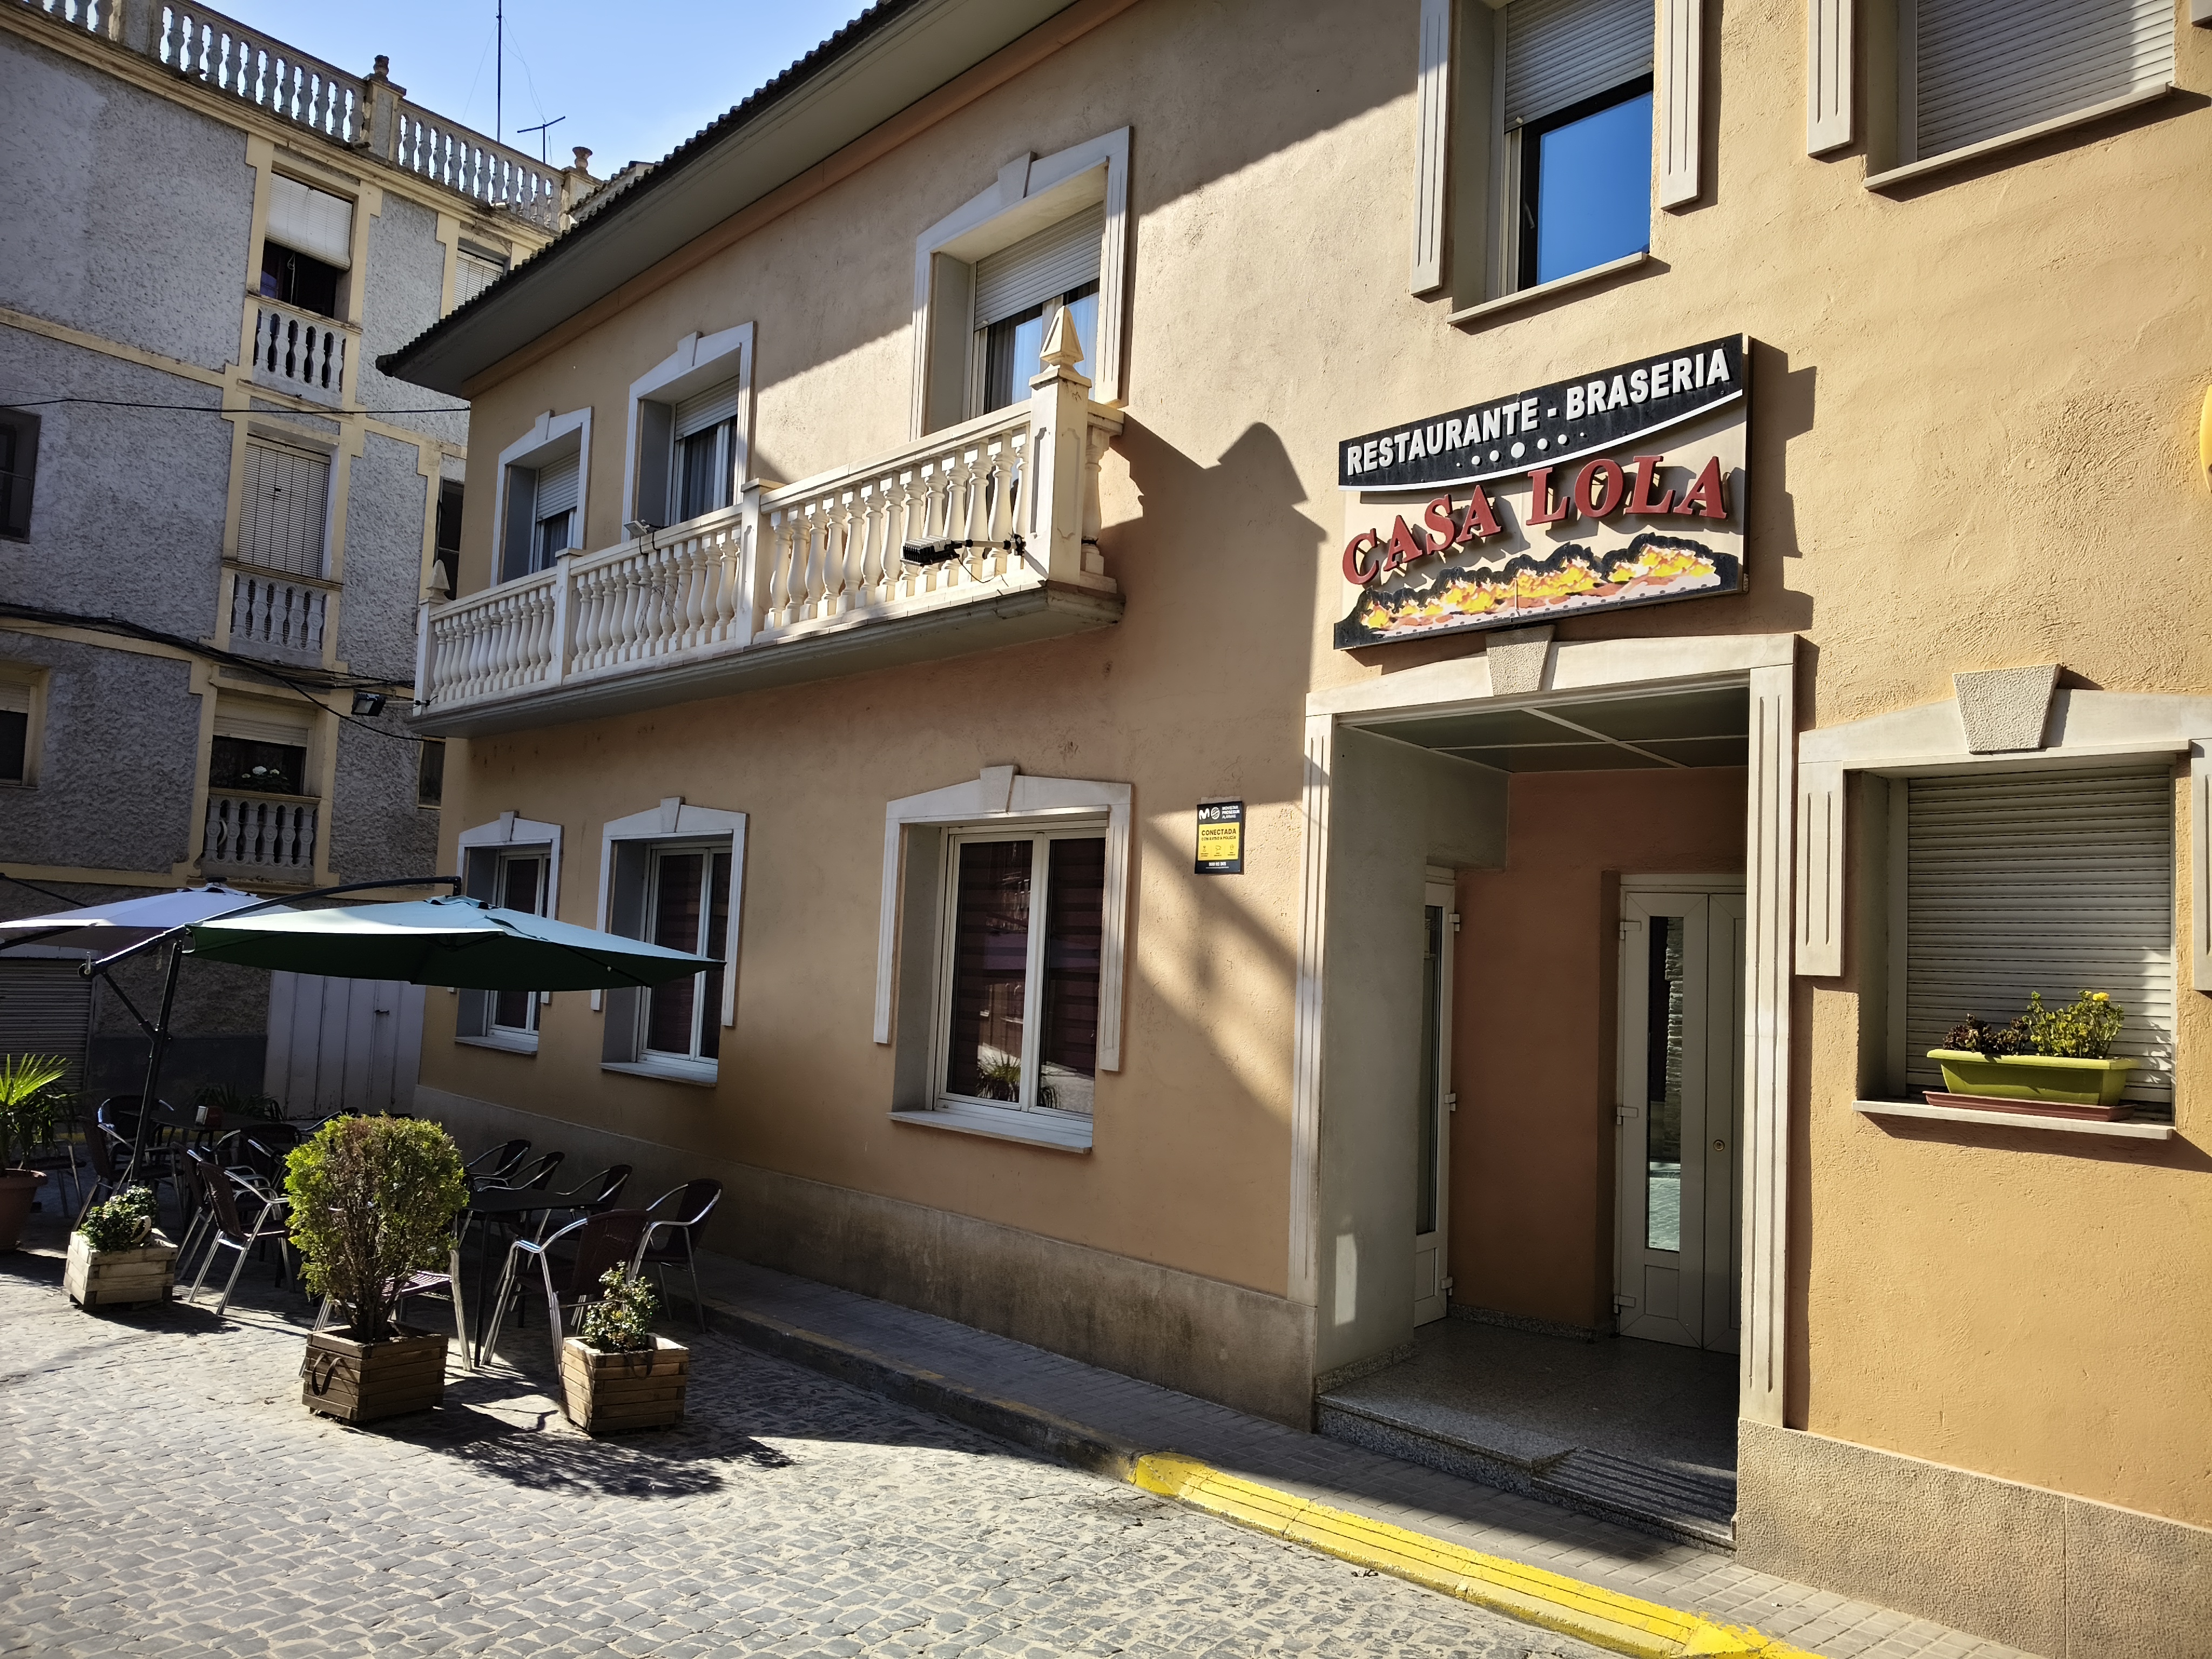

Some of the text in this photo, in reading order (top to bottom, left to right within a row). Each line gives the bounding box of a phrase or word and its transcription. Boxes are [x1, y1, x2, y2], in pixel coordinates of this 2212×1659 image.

[1347, 397, 1539, 476] RESTAURANTE
[1566, 348, 1730, 421] BRASERIA
[1342, 455, 1728, 585] CASA LOLA
[1202, 828, 1237, 836] CONECTADA
